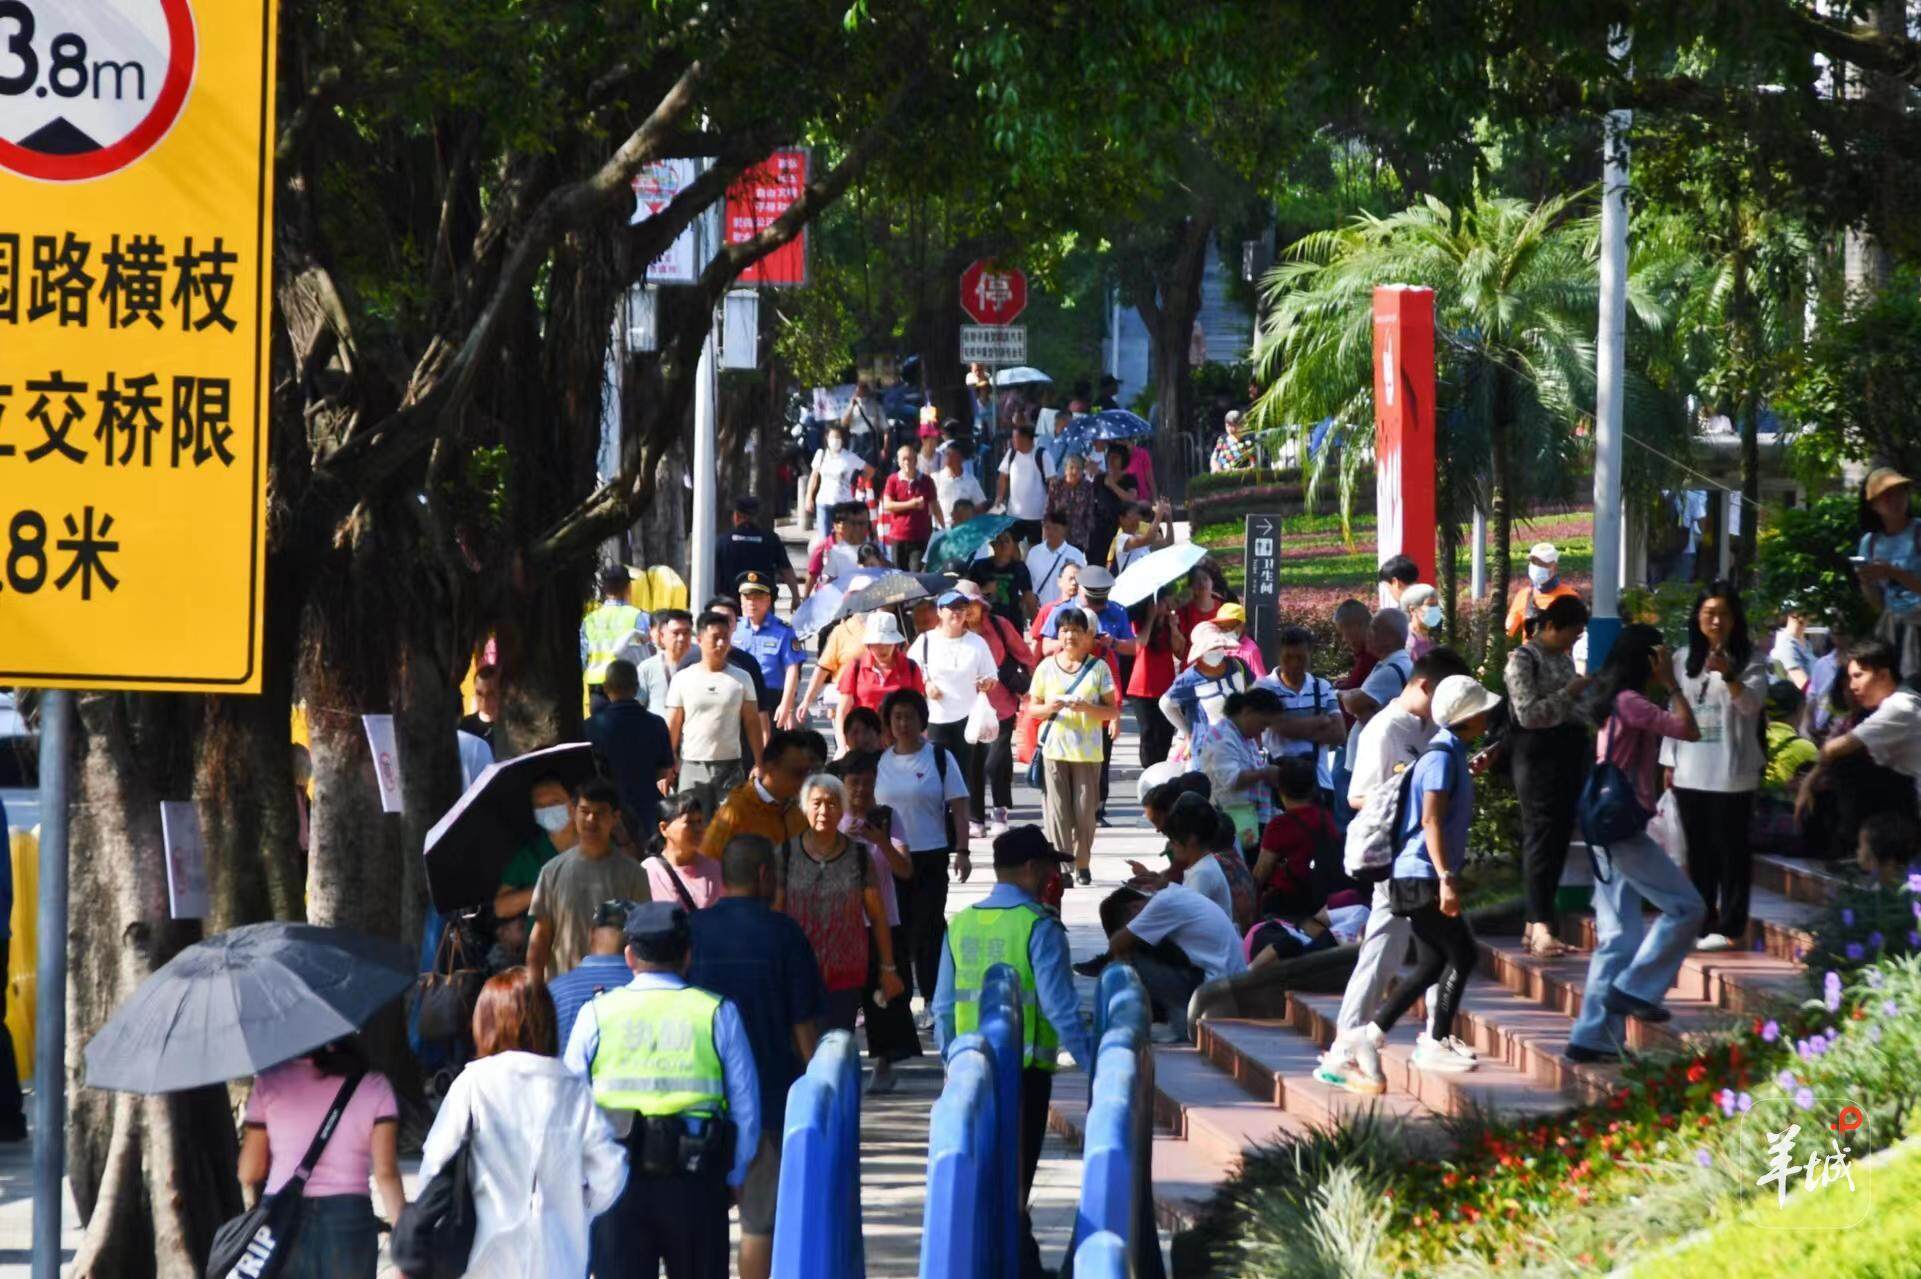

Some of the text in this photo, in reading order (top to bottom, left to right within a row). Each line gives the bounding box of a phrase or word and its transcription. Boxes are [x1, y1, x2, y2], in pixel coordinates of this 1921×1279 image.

[0, 0, 145, 100] 3.8m
[975, 272, 1013, 312] 停
[1260, 558, 1274, 595] 卫生间
